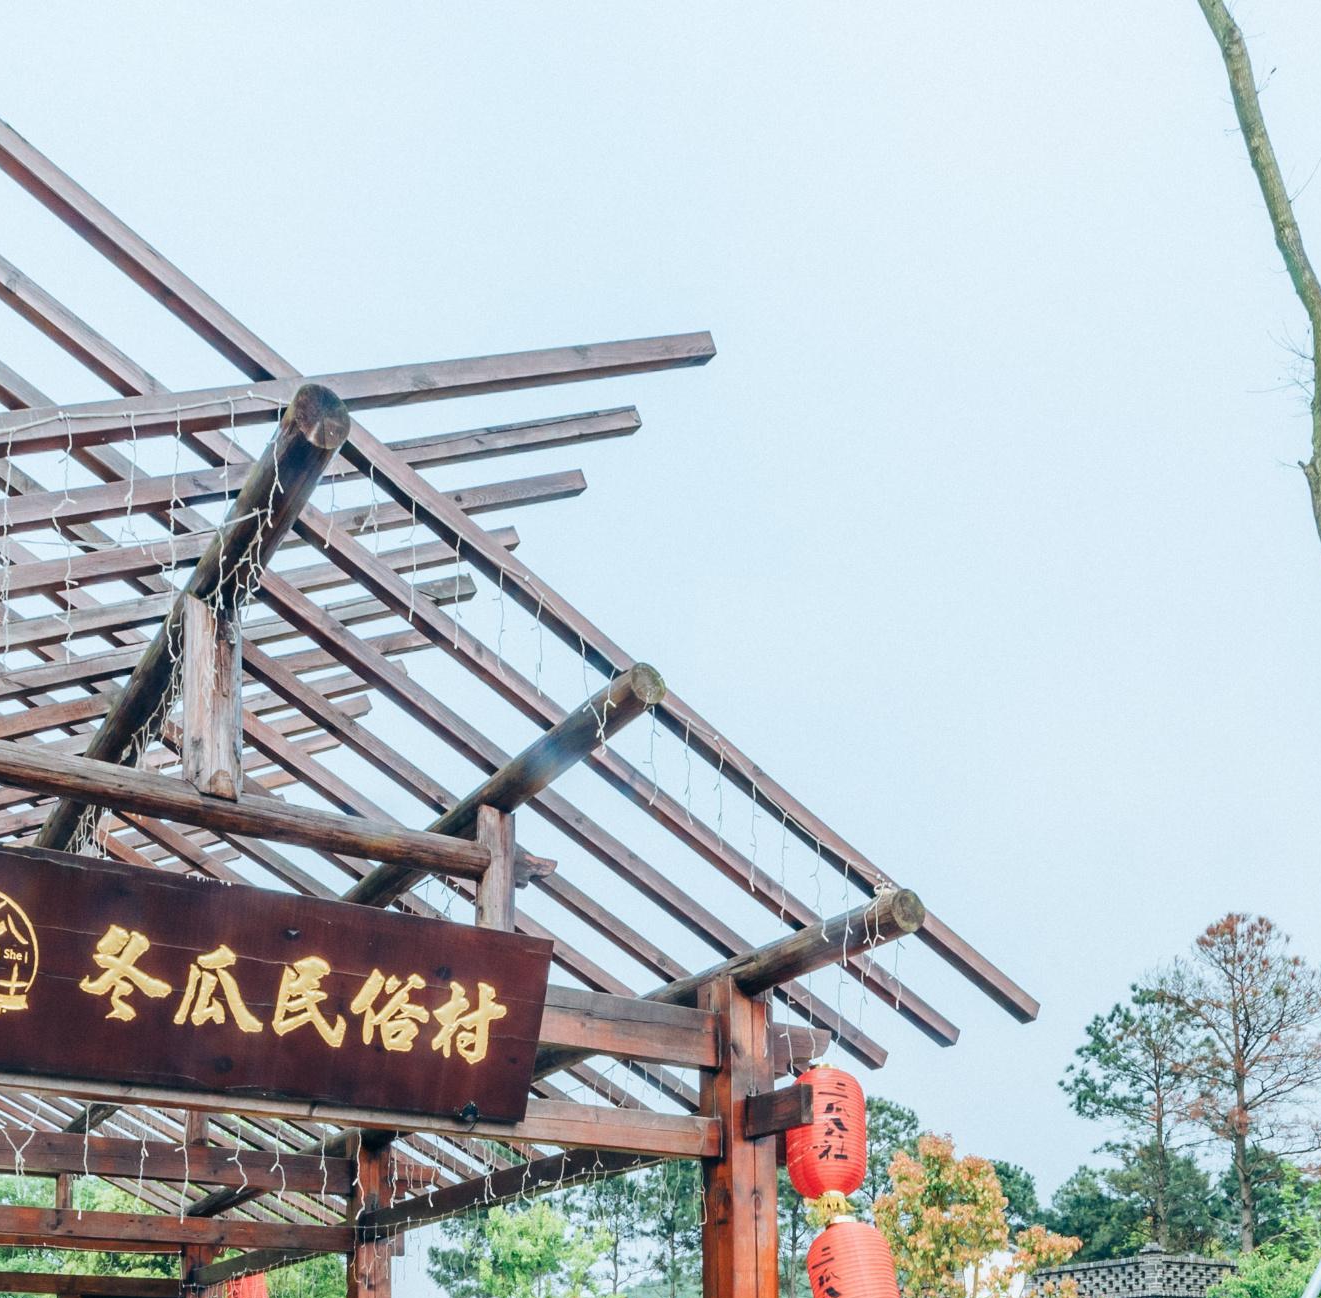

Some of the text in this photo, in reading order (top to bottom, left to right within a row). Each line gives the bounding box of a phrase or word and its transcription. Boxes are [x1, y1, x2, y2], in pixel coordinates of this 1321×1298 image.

[3, 948, 23, 961] She
[80, 924, 508, 1065] 冬瓜民俗村
[817, 1081, 849, 1161] 三瓜公社
